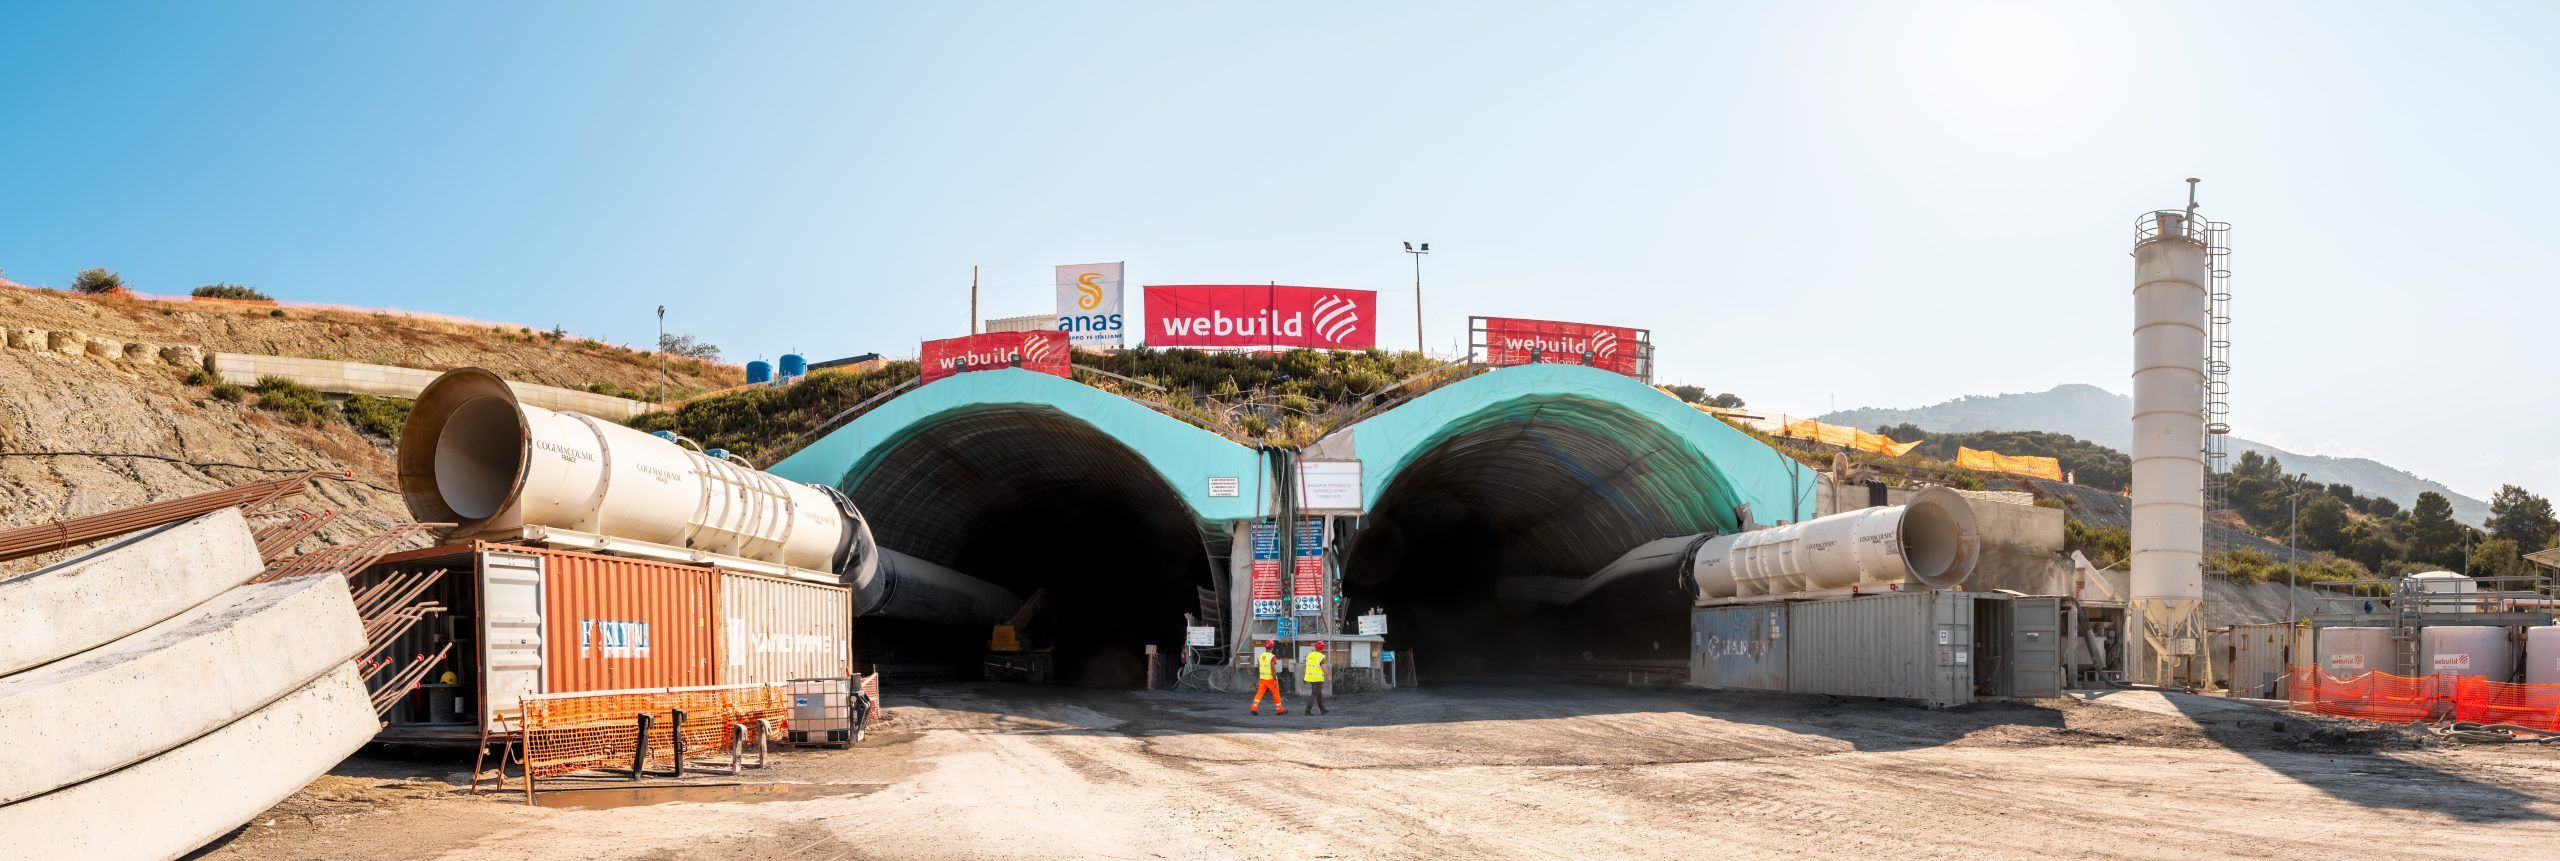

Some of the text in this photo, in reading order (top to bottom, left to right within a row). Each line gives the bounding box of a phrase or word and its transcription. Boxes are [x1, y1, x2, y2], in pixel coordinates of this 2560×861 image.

[1058, 313, 1122, 332] anas
[1163, 309, 1302, 338] webuild
[561, 454, 576, 464] FRANCE
[2434, 655, 2458, 665] webuild
